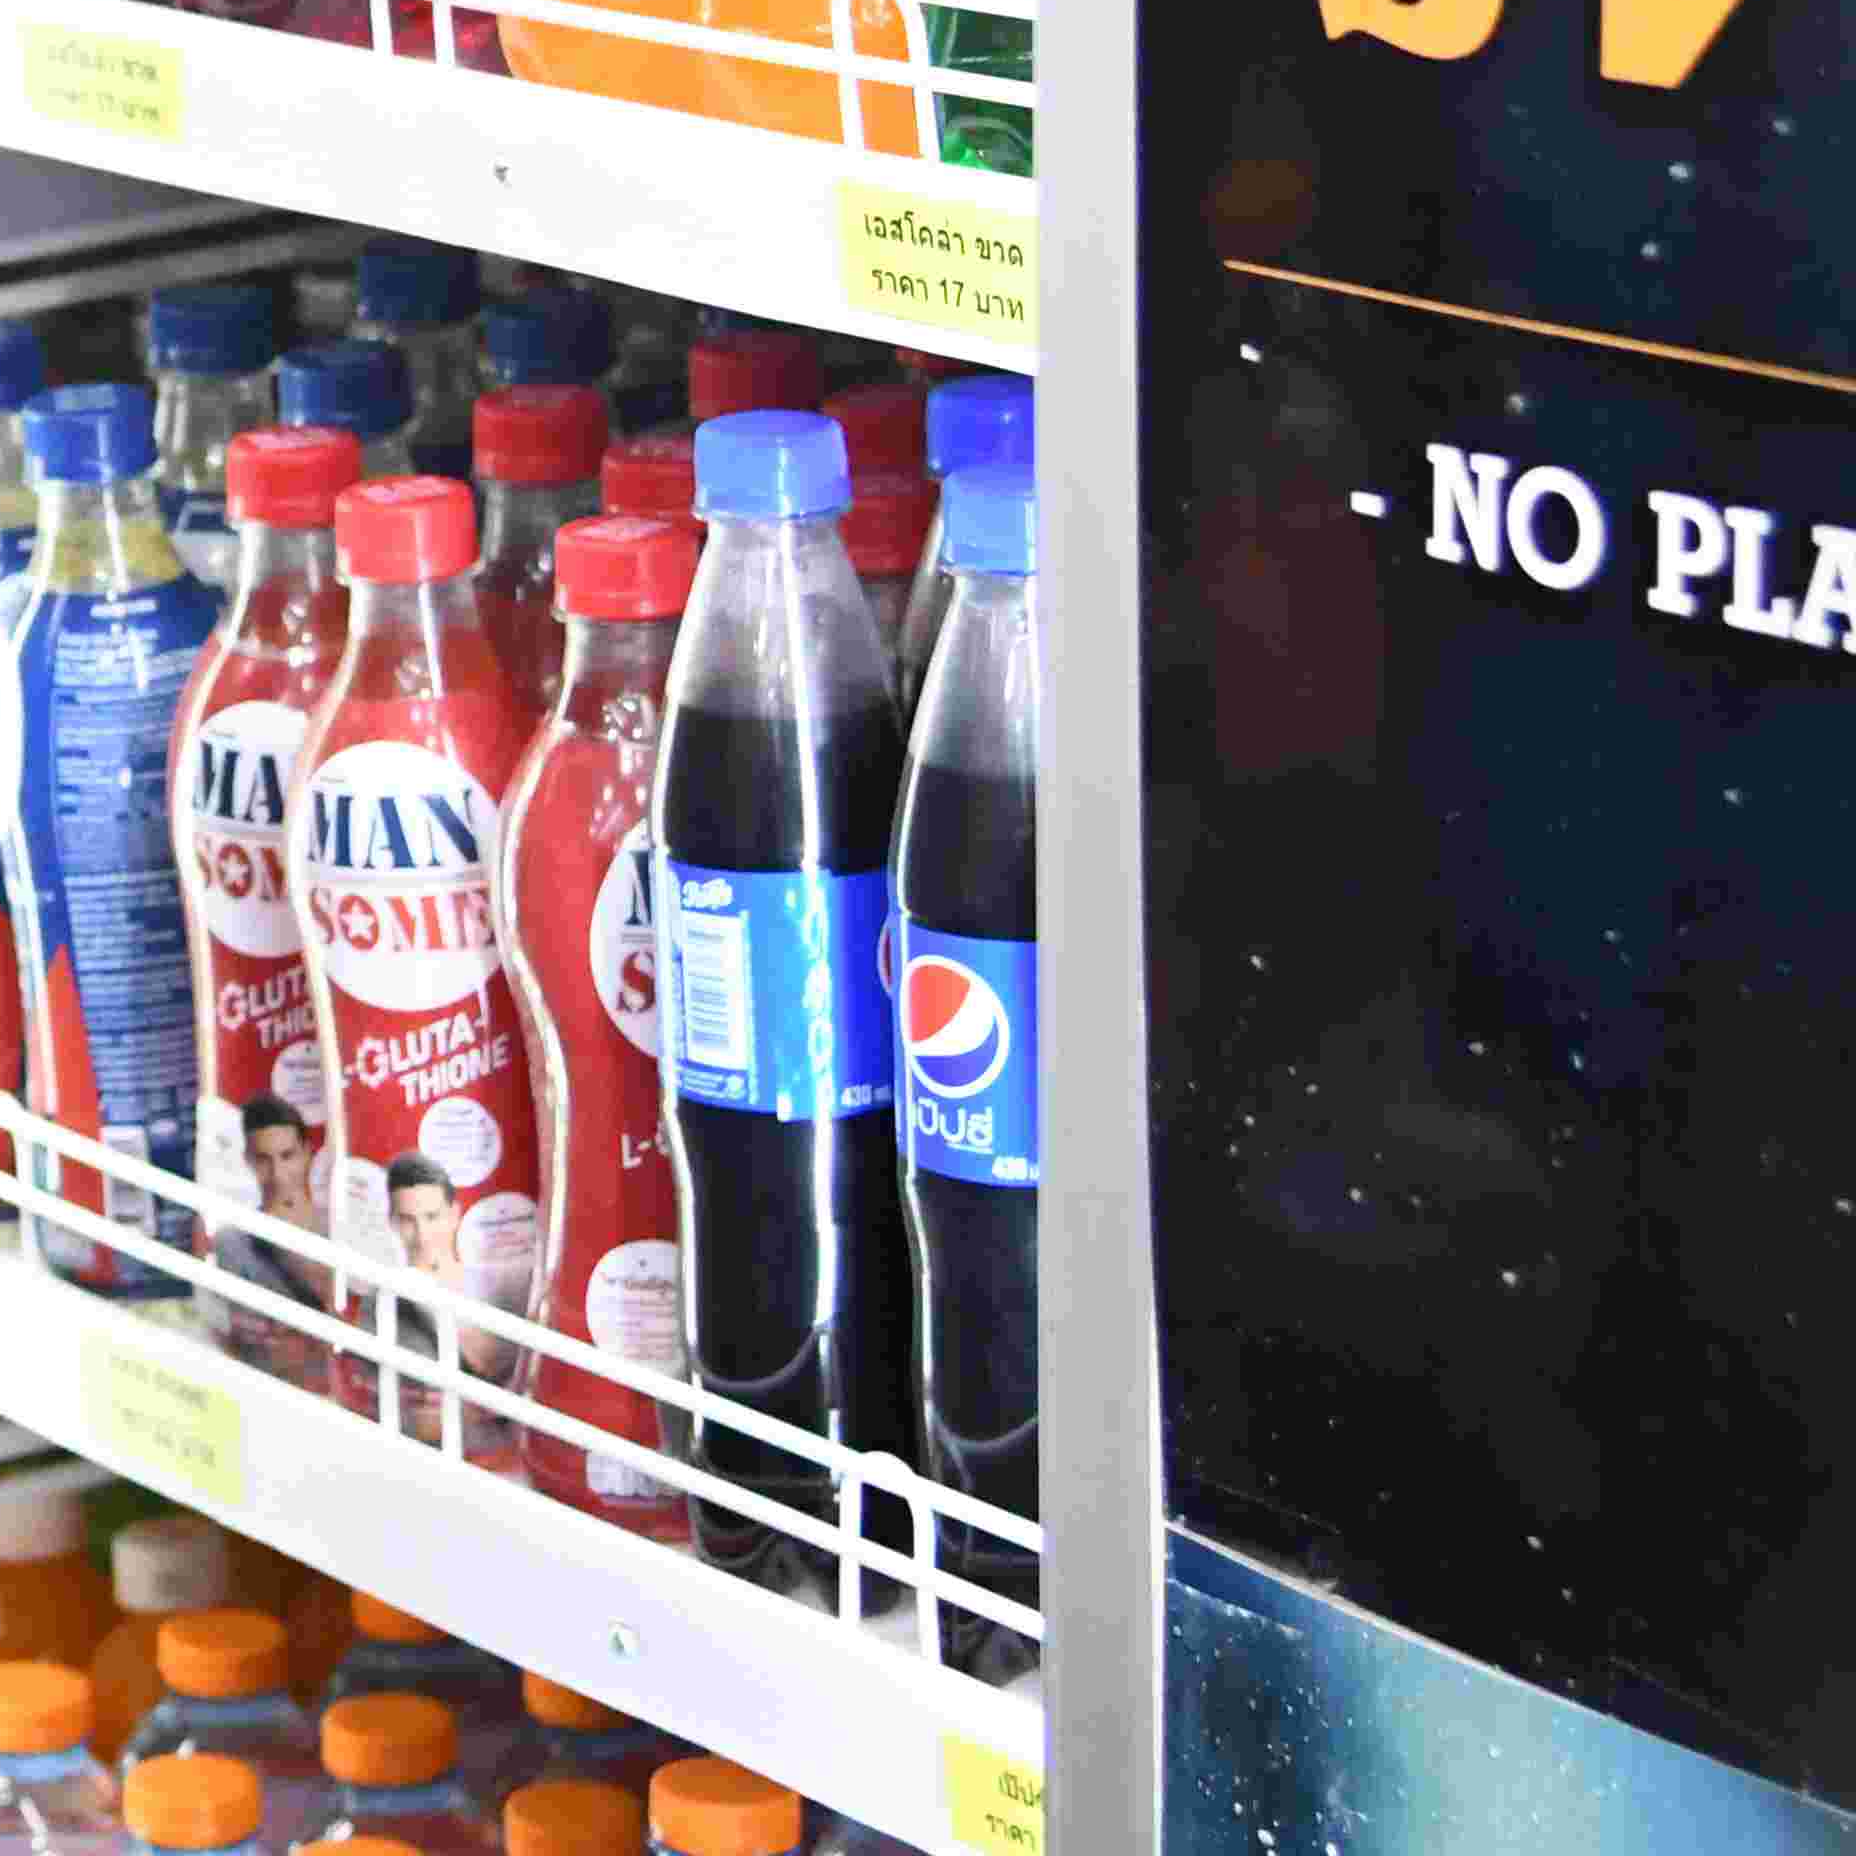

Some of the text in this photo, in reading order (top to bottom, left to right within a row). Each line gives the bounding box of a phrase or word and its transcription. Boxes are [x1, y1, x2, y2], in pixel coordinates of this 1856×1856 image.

[872, 269, 1024, 321] ราคา 17 บาท
[1425, 443, 1605, 591] NO
[307, 788, 481, 870] MAN
[398, 1032, 510, 1108] THIONE
